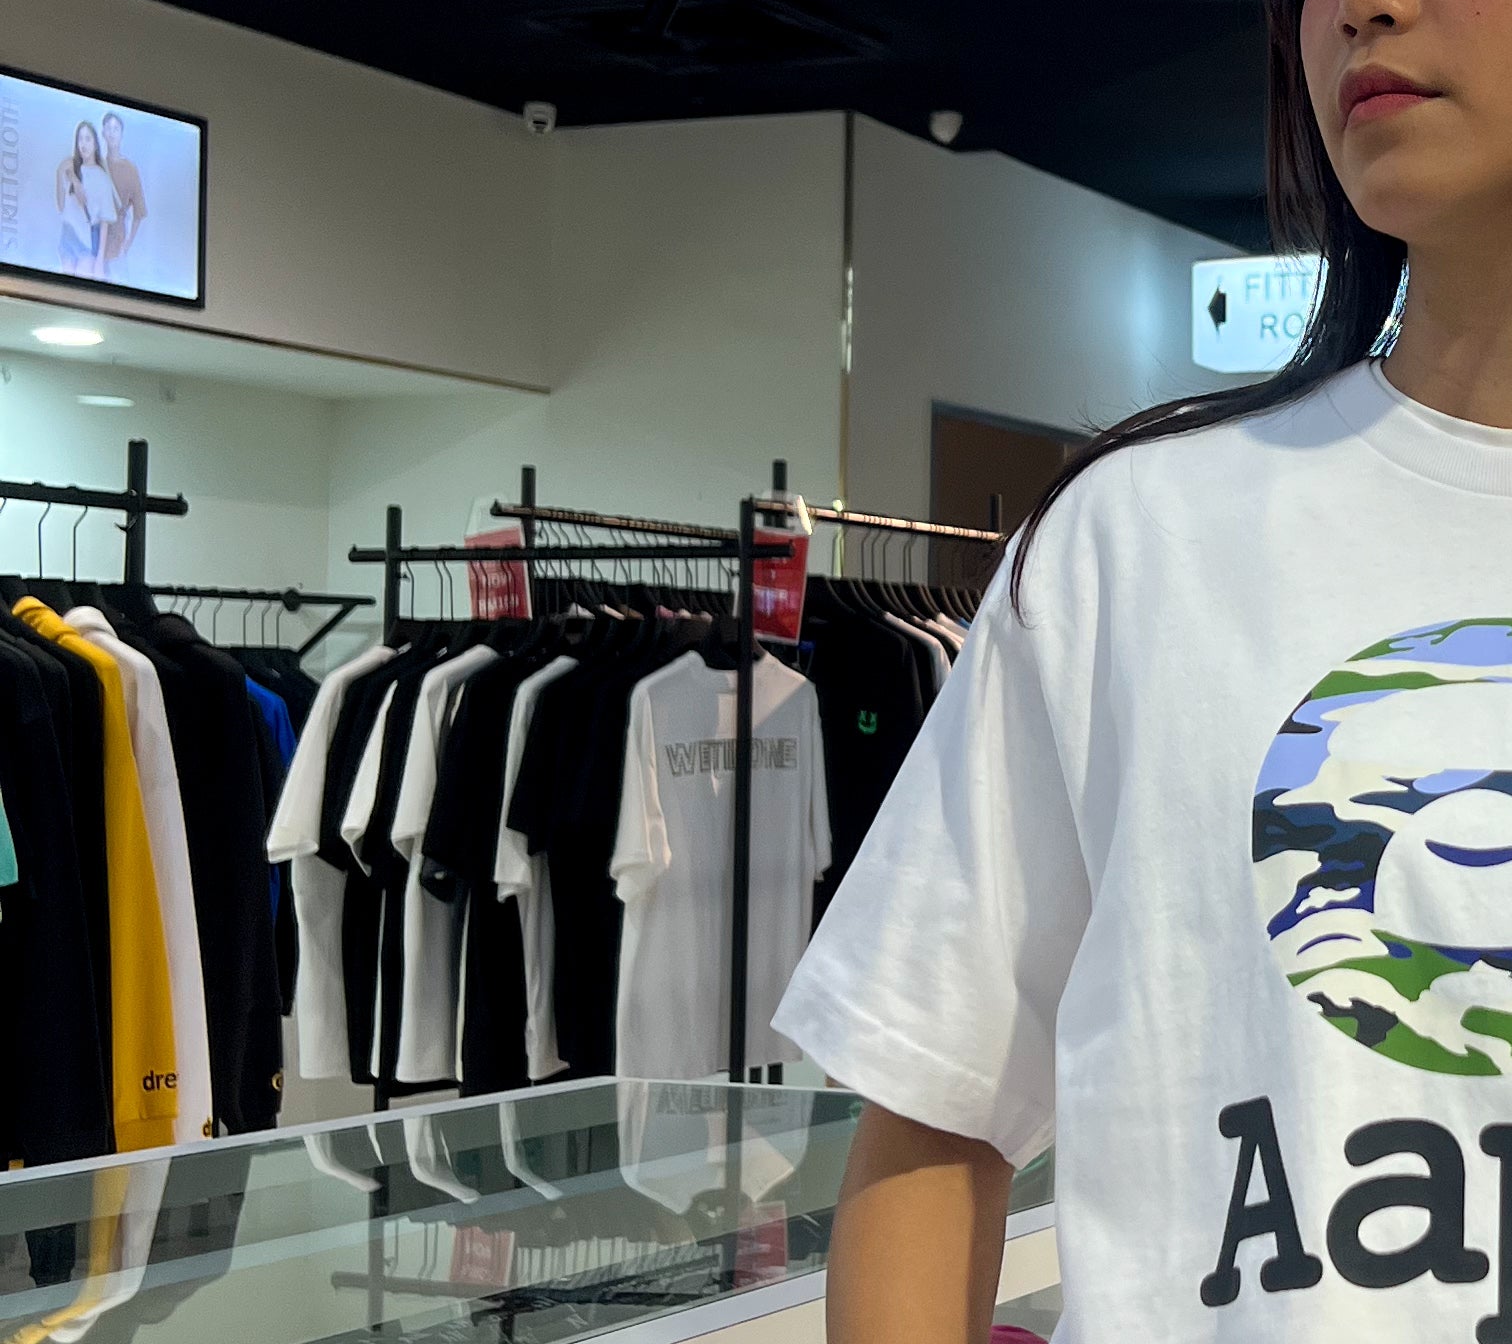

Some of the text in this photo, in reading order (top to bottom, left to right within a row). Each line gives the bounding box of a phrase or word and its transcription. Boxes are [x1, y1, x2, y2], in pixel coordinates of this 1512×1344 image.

[1244, 272, 1312, 302] FITT
[1259, 312, 1305, 339] RO
[143, 1070, 178, 1091] dre
